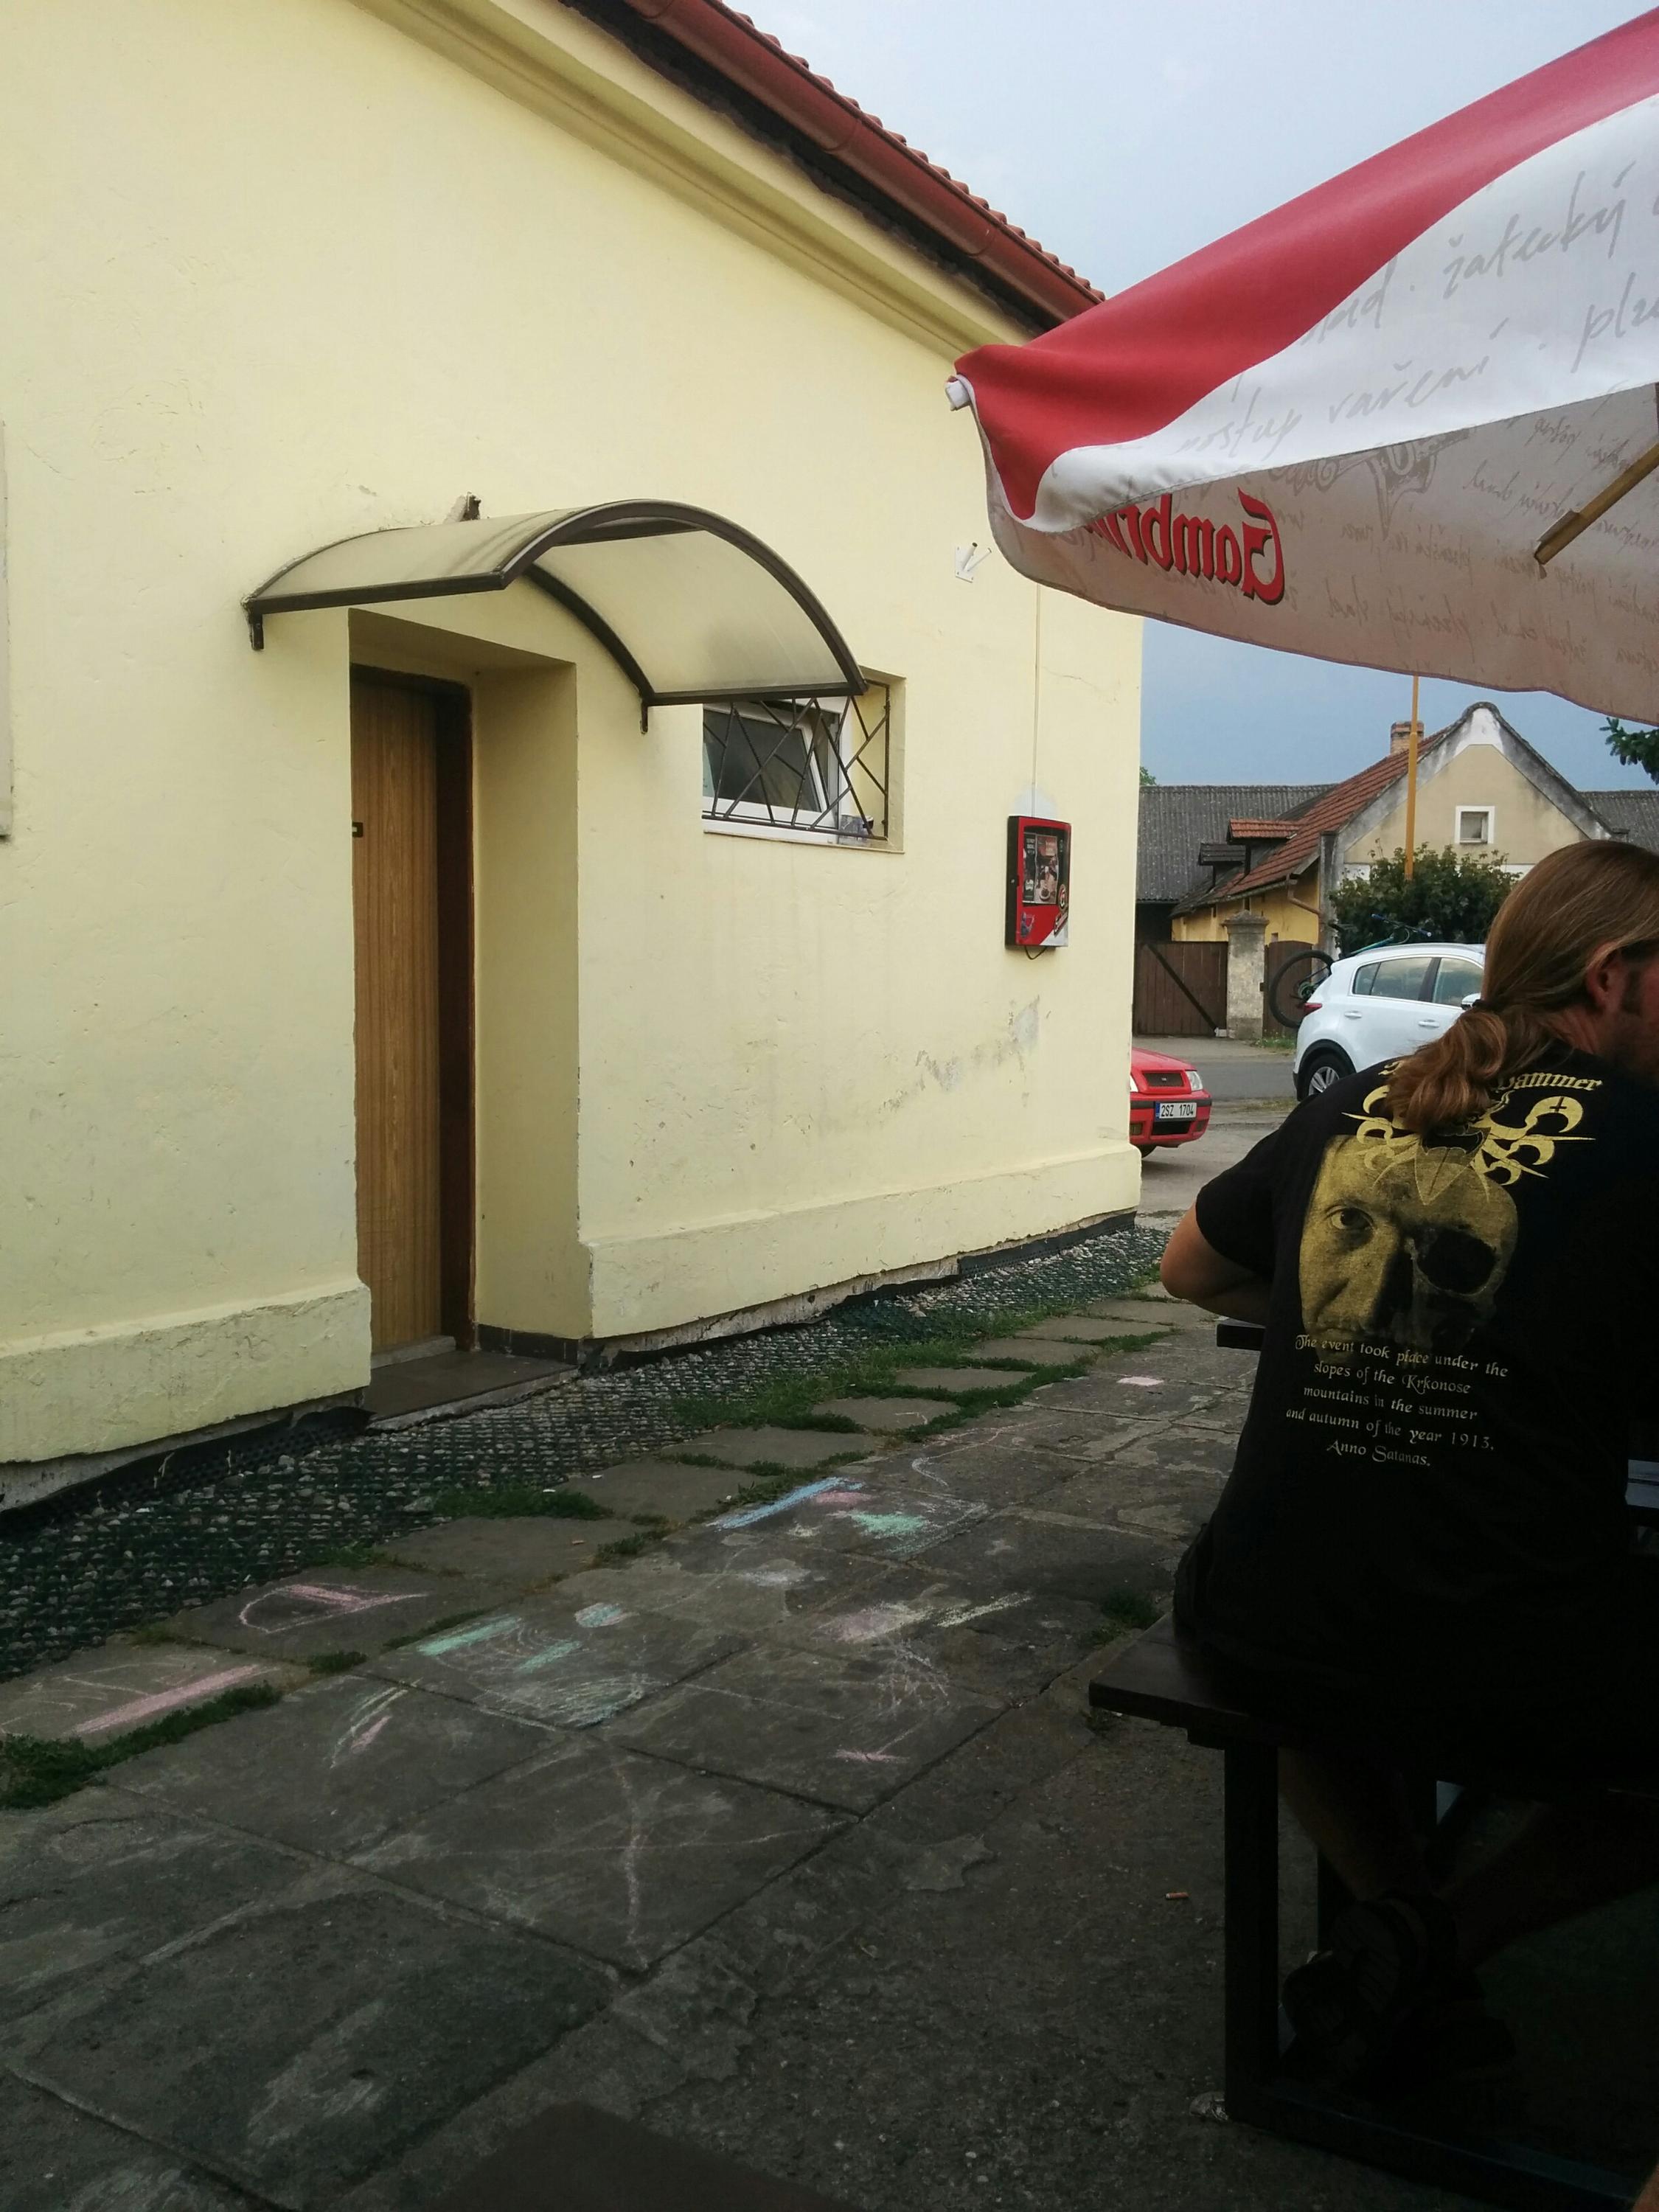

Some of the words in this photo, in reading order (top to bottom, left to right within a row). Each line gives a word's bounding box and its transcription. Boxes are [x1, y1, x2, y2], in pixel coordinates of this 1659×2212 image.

[1161, 1105, 1175, 1117] 2SZ
[1179, 1104, 1194, 1116] 1704
[1295, 1335, 1316, 1350] The
[1321, 1340, 1354, 1352] event
[1360, 1343, 1390, 1359] took
[1396, 1349, 1429, 1366] place
[1435, 1355, 1478, 1371] under
[1485, 1363, 1509, 1377] the
[1314, 1360, 1351, 1379] slopes
[1357, 1367, 1370, 1385] of
[1374, 1369, 1395, 1384] the
[1402, 1374, 1471, 1395] Krkonose
[1304, 1387, 1369, 1406] mountains
[1374, 1394, 1384, 1408] in
[1391, 1399, 1413, 1413] the
[1419, 1404, 1478, 1420] summer
[1286, 1408, 1306, 1420] and
[1309, 1411, 1360, 1430] autumn
[1366, 1419, 1382, 1438] of
[1385, 1422, 1401, 1436] the
[1409, 1429, 1442, 1444] year
[1326, 1439, 1367, 1456] Anno
[1371, 1445, 1431, 1467] Satanas.
